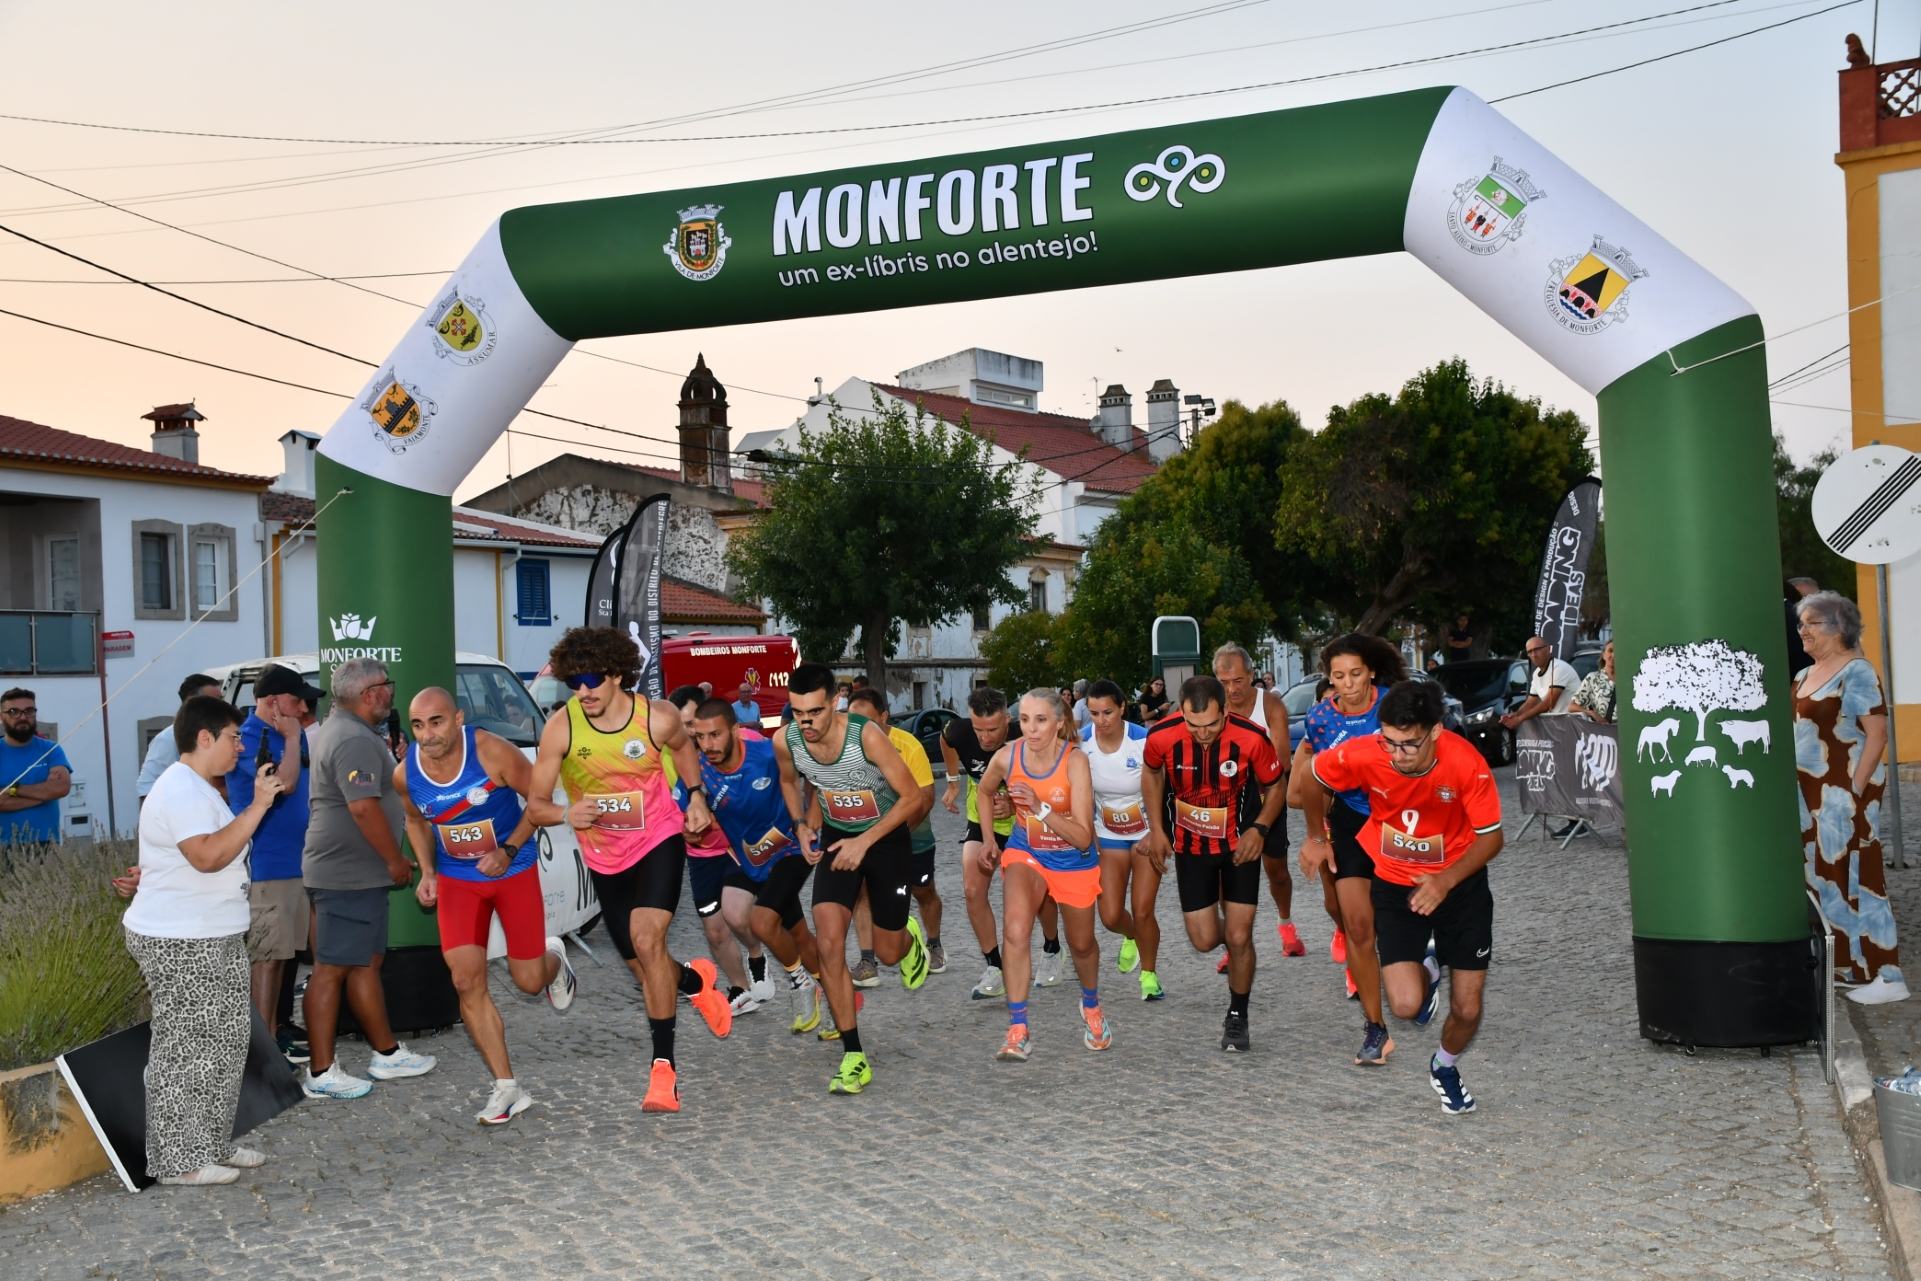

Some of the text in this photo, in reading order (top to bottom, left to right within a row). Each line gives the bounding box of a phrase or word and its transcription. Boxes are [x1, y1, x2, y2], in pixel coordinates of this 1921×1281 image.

[772, 152, 1094, 256] MONFORTE
[1448, 211, 1456, 230] SANTO
[1470, 244, 1498, 254] MONFORTE
[674, 257, 724, 280] VILA DE MONFORTE
[778, 230, 1098, 287] um ex-líbris no alentejo!
[1546, 280, 1607, 333] FREGUESIA DE MONFORTE
[467, 331, 496, 365] ASSUMAR
[403, 414, 430, 445] VAIAMONTE
[1545, 528, 1558, 571] PRODUÇÃO
[1538, 580, 1548, 608] DESIGN
[1540, 526, 1582, 659] OADING
[1563, 570, 1585, 627] IDEAS
[648, 610, 659, 621] DO
[1535, 610, 1543, 621] DE
[690, 645, 767, 656] BOMBEIROS MONFORTE
[597, 797, 631, 813] 534
[833, 795, 864, 808] 535
[1112, 812, 1130, 823] 80
[1190, 809, 1210, 823] 46
[1401, 809, 1419, 836] 9
[449, 826, 483, 843] 543
[1393, 833, 1431, 852] 540
[749, 839, 774, 856] 541
